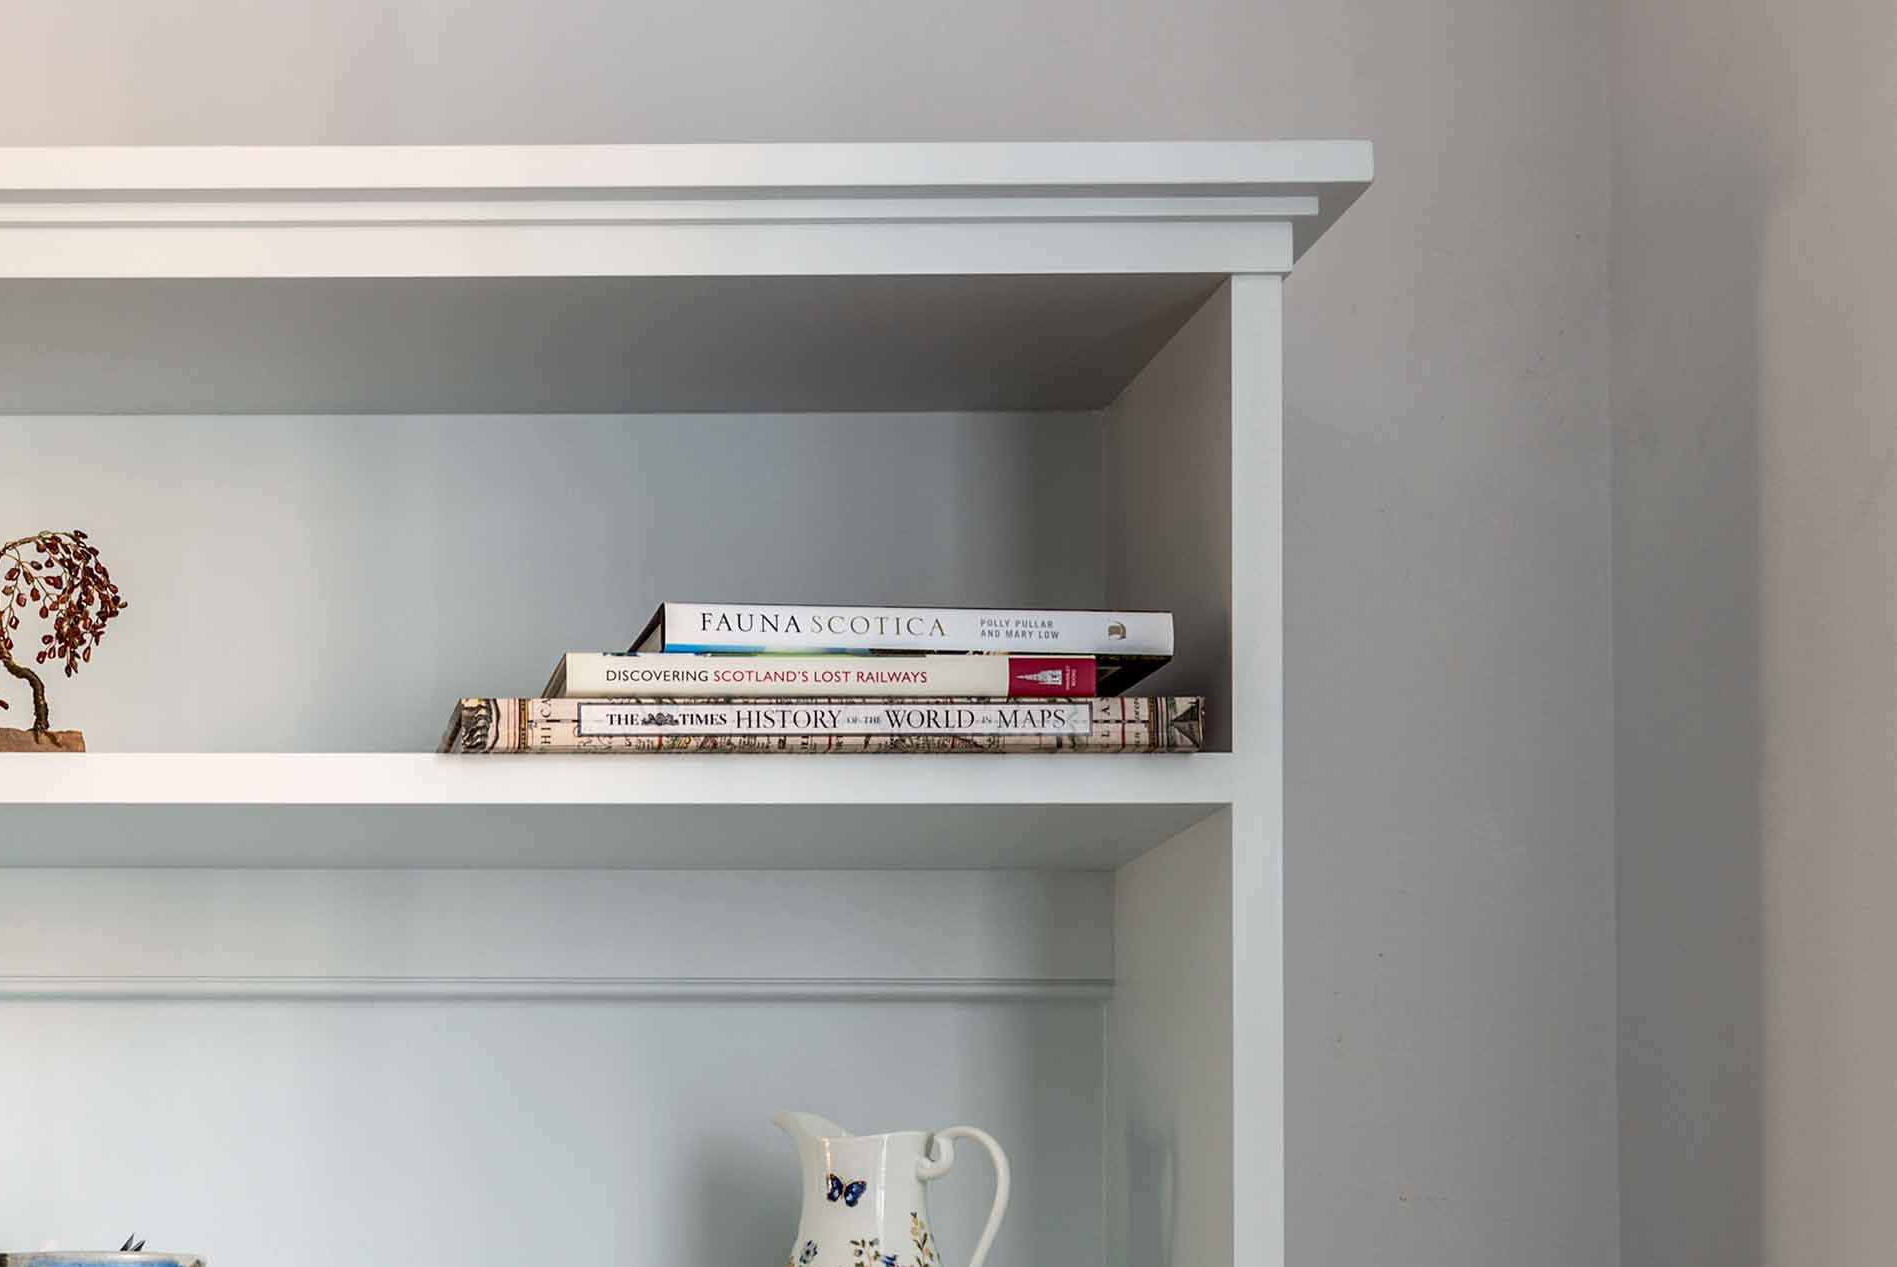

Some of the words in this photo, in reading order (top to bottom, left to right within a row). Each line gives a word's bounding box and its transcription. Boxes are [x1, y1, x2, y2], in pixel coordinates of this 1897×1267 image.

[701, 612, 802, 634] FAUNA
[810, 615, 947, 637] SCOTICA
[980, 618, 1010, 628] POLLY
[1014, 619, 1054, 629] PULLAR
[980, 629, 1002, 638] AND
[1005, 629, 1035, 639] MARY
[1039, 630, 1060, 639] LOW
[605, 669, 709, 683] DISCOVERING
[713, 670, 809, 683] SCOTLAND'S
[813, 671, 851, 683] LOST
[855, 671, 928, 683] RAILWAYS
[605, 713, 640, 726] THE
[678, 713, 728, 726] TIMES
[735, 710, 841, 730] HISTORY
[846, 716, 861, 725] OF
[863, 716, 882, 725] THE
[884, 709, 975, 729] WORLD
[981, 716, 993, 725] IN
[997, 709, 1066, 729] MAPS
